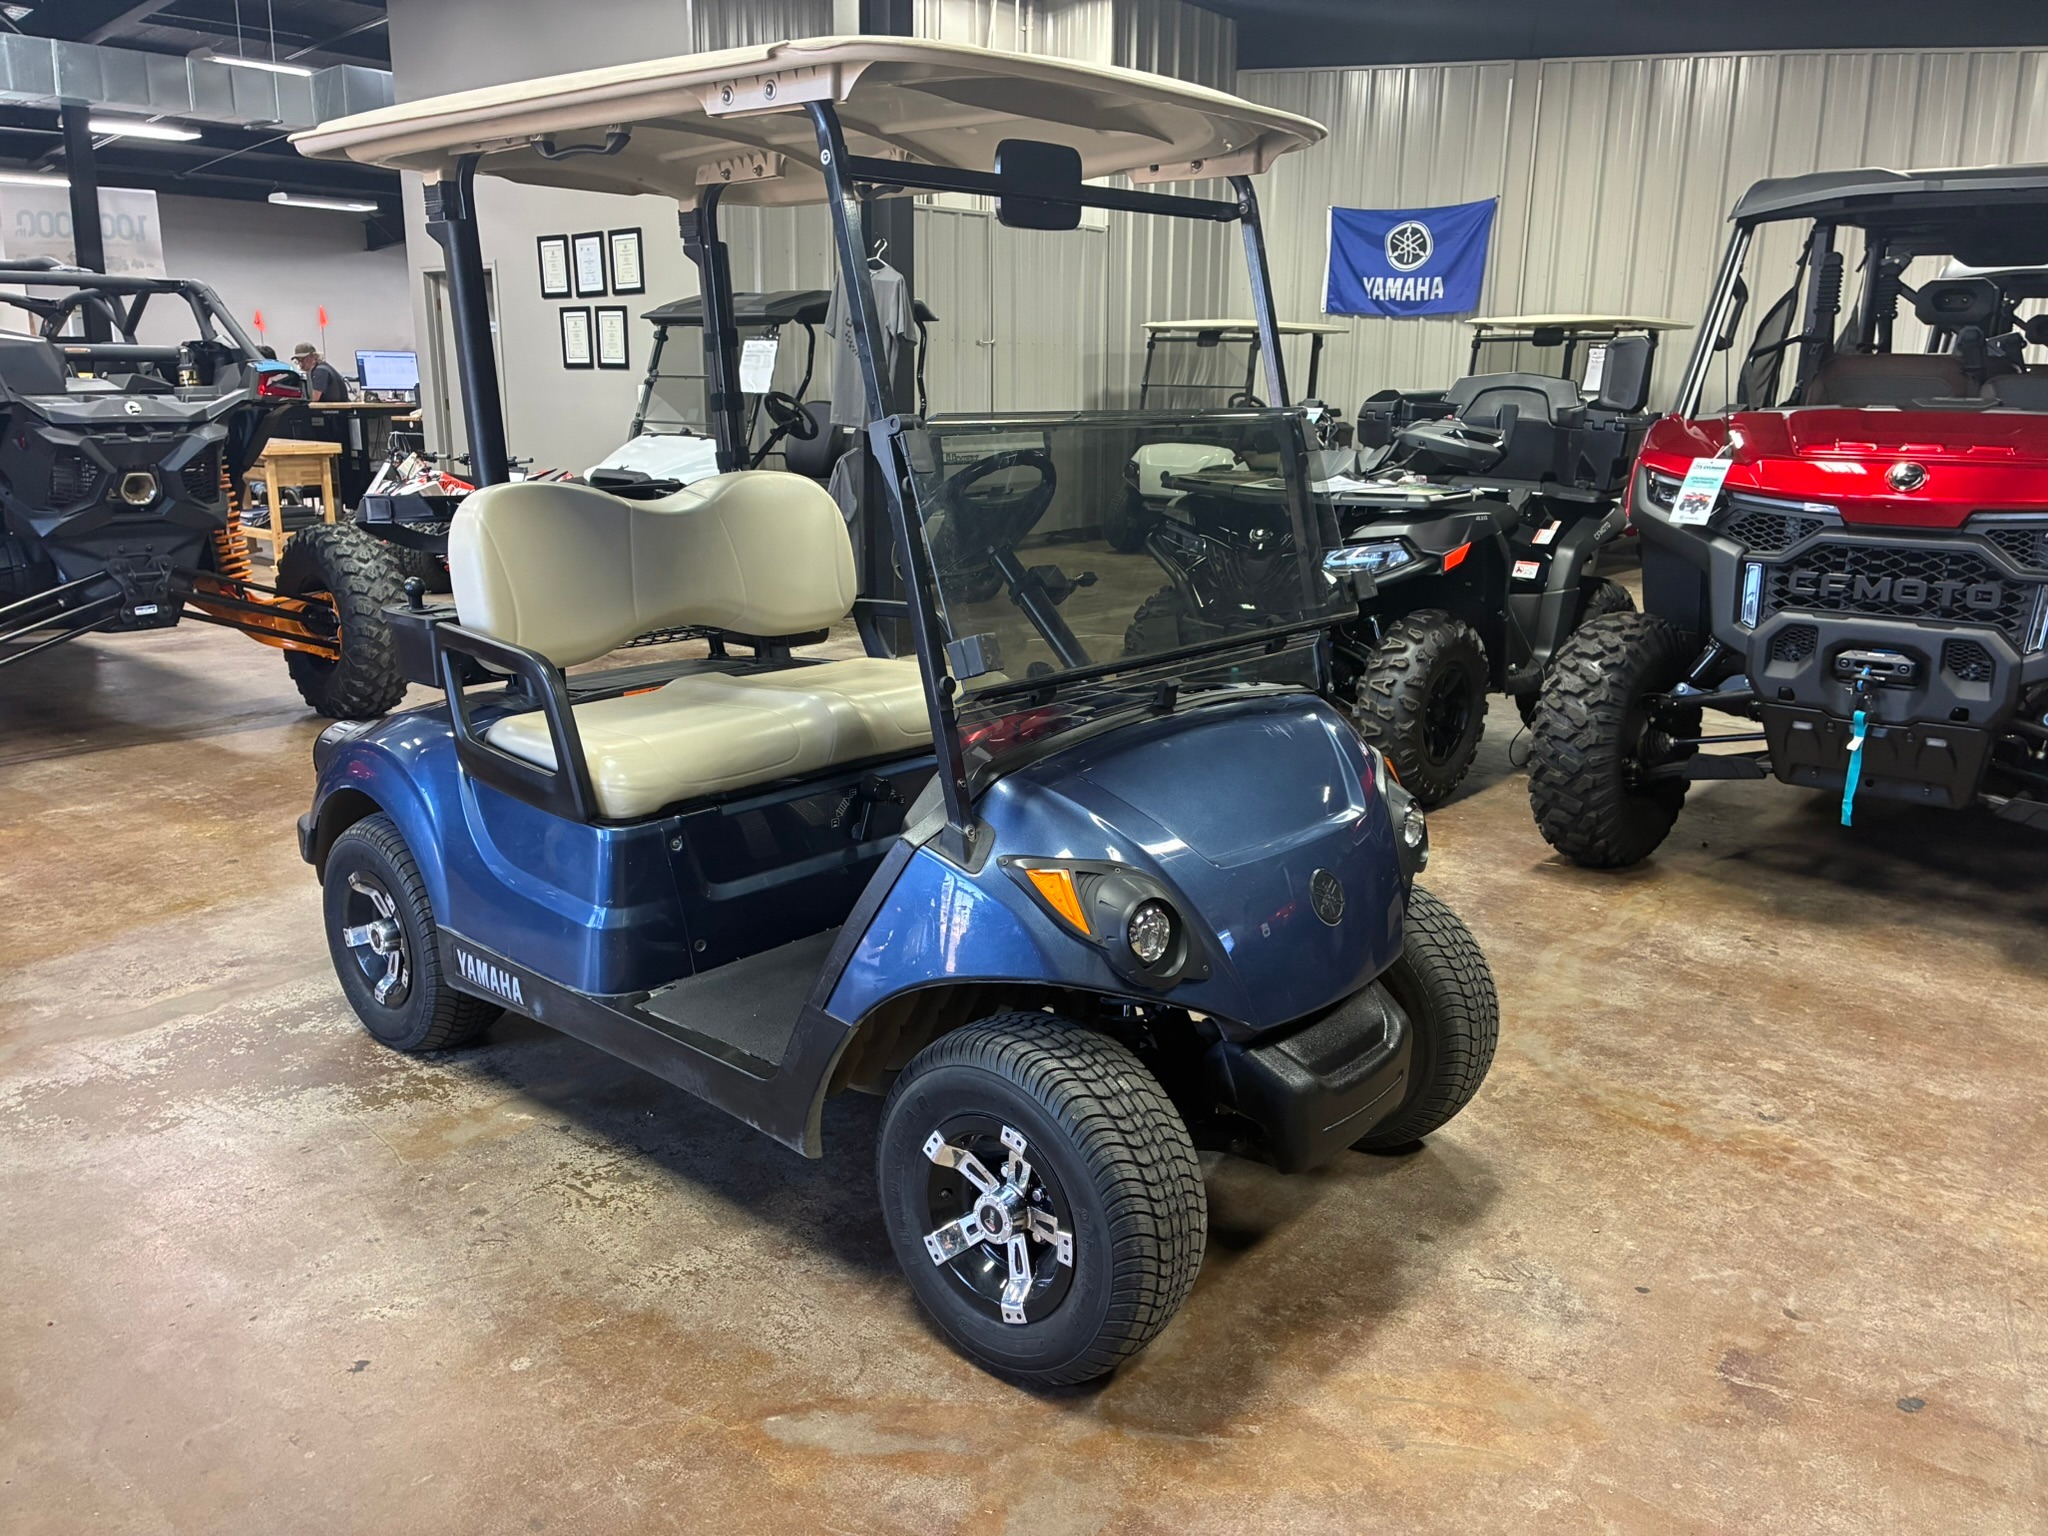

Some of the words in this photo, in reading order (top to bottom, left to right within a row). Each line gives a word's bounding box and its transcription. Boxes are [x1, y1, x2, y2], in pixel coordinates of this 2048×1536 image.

[1363, 276, 1444, 301] YAMAHA
[1788, 571, 2001, 610] CFMOTO
[456, 948, 525, 1006] YAMAHA
